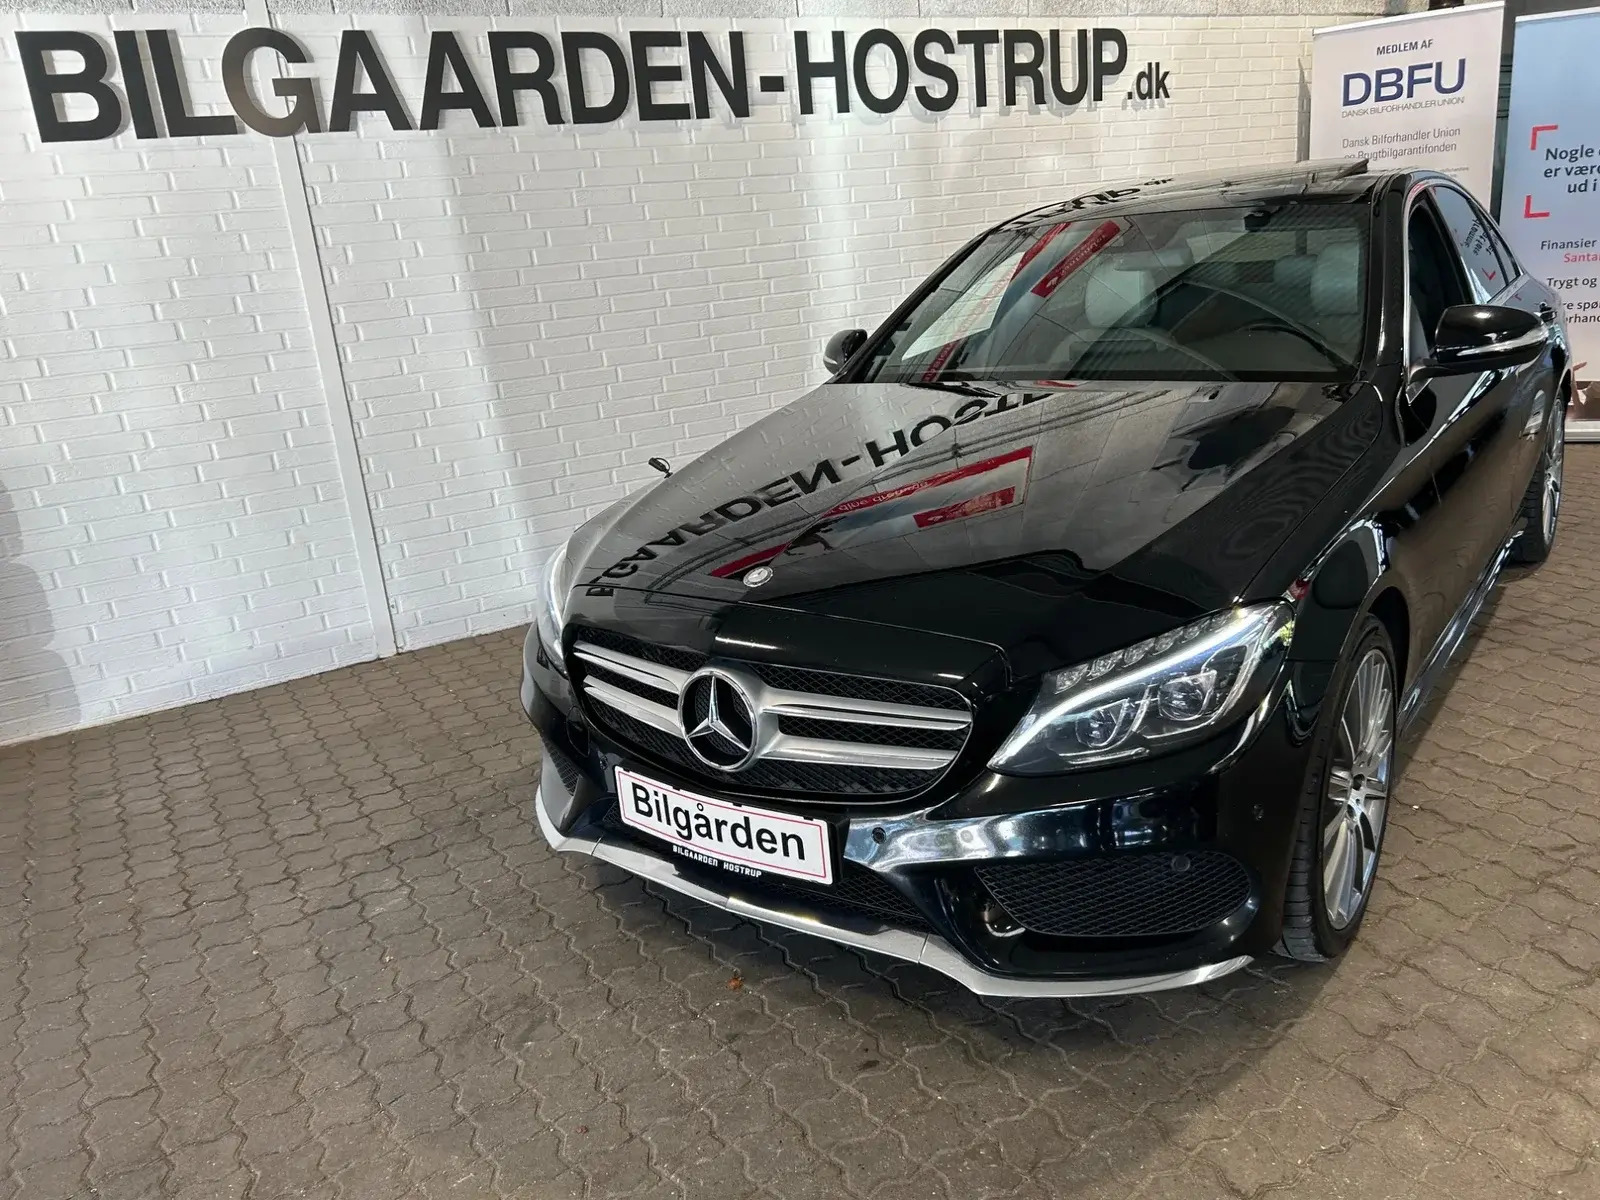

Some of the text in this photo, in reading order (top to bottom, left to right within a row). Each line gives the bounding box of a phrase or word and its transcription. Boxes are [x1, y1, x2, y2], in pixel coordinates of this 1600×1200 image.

[1376, 38, 1434, 56] MEDLEM AF
[1342, 58, 1466, 107] DBFU
[1341, 96, 1465, 119] DANSK BILFORHANDLER UNION
[1342, 126, 1461, 149] Dansk Bilforhandler Union
[1357, 142, 1457, 161] Brugtbilgarantifonden
[1545, 144, 1595, 163] Nogle
[1543, 166, 1561, 178] er
[1567, 178, 1598, 194] ud i
[1540, 238, 1598, 251] Finansier
[1563, 252, 1600, 263] Santa
[1546, 276, 1598, 290] Trygt og
[1577, 301, 1600, 312] spø
[1566, 313, 1600, 324] rhan
[631, 781, 806, 861] Bilgården
[672, 844, 762, 878] BILGAARDEN HOSTRUP
